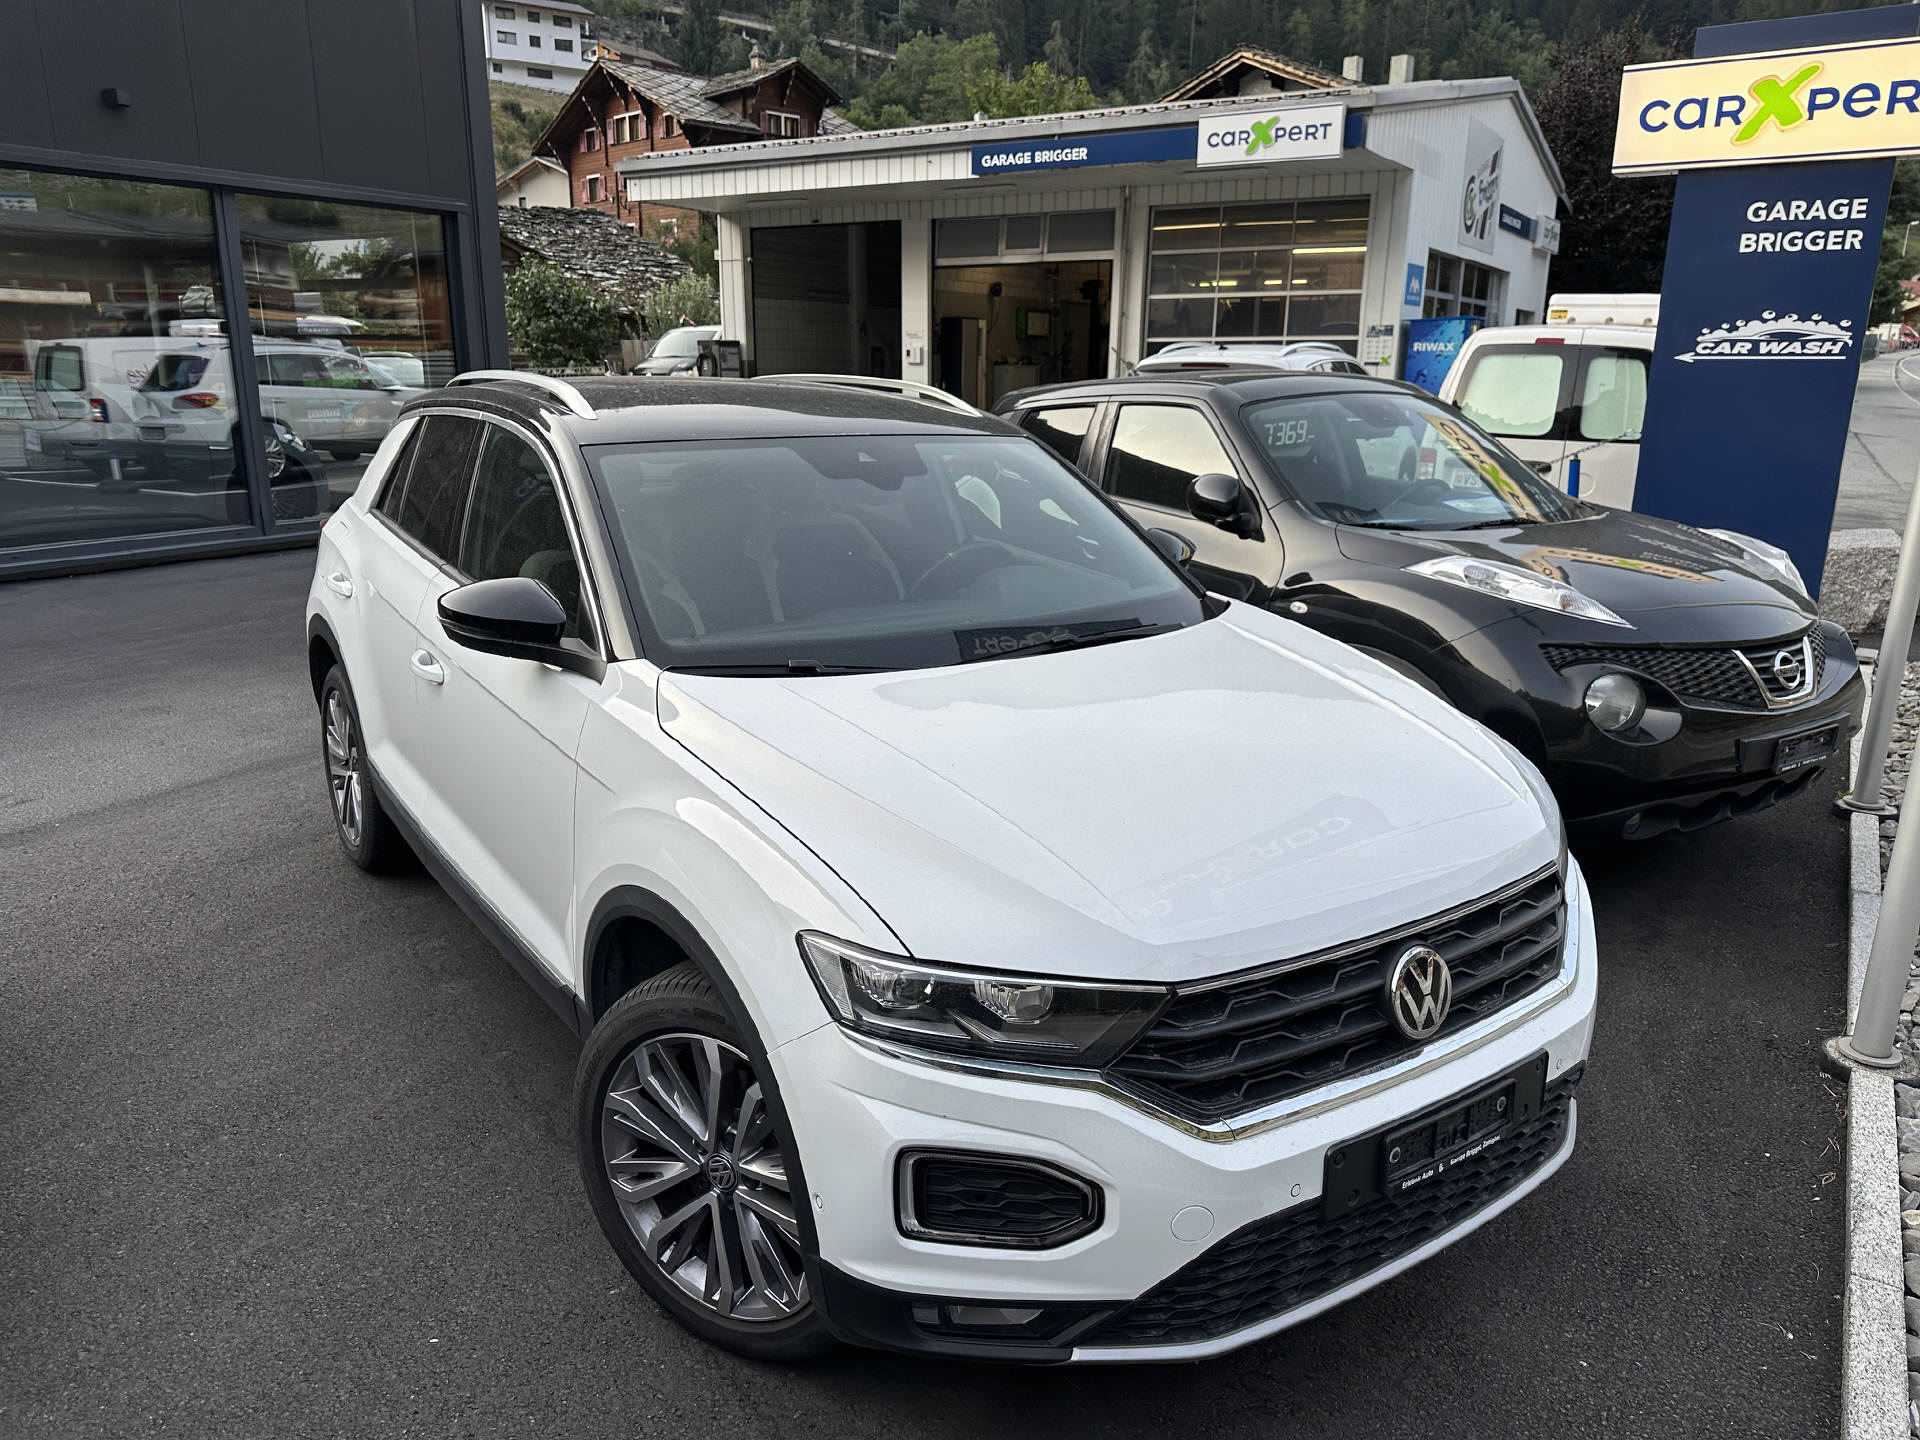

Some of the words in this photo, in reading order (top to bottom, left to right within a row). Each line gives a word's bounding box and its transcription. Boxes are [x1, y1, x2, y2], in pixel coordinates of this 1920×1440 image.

[981, 151, 1032, 167] GARAGE
[1034, 147, 1088, 163] BRIGGER
[1746, 198, 1869, 223] GARAGE
[1739, 229, 1864, 253] BRIGGER
[1413, 341, 1455, 352] RIWAX
[1696, 341, 1752, 354] CAR
[1759, 341, 1844, 354] WASH
